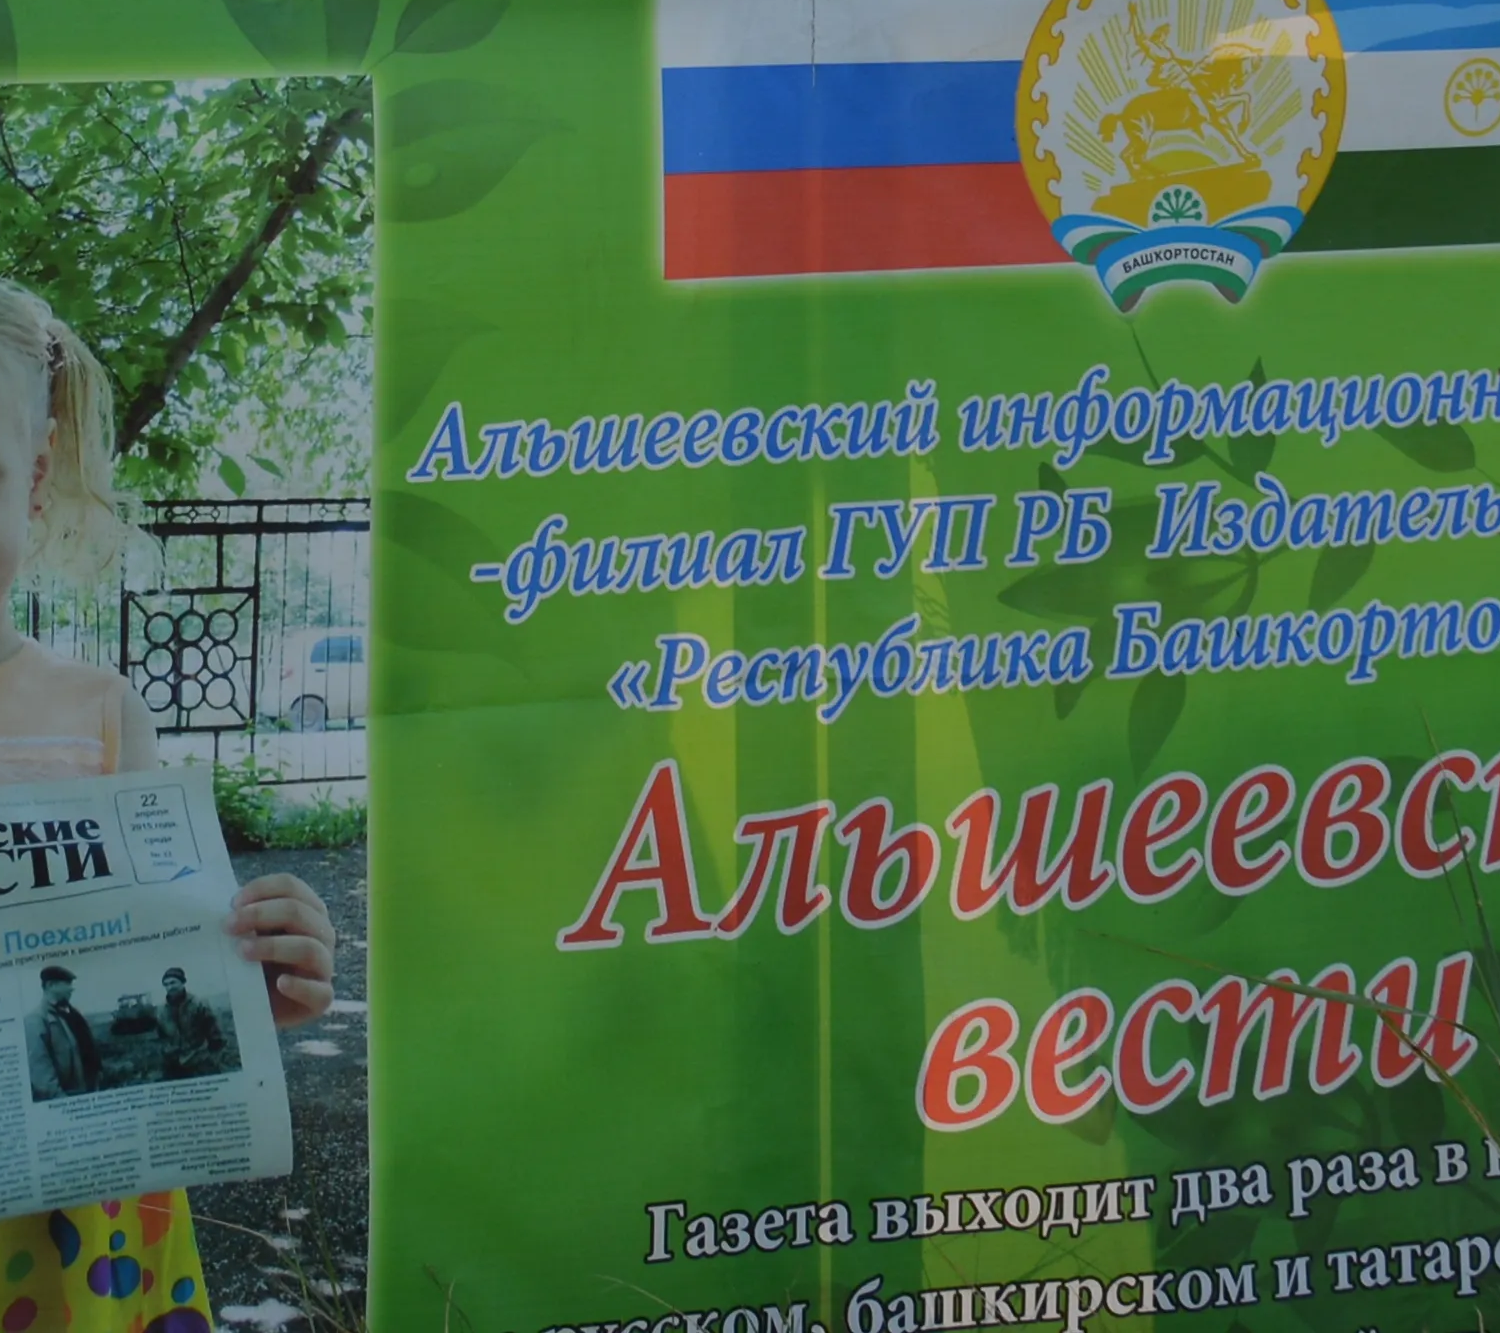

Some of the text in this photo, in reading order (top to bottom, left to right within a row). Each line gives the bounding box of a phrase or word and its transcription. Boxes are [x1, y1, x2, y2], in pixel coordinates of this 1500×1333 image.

[407, 379, 937, 481] Альшеевский
[470, 515, 805, 623] -филиал
[823, 495, 995, 579] ГУП
[1006, 488, 1111, 566] РБ
[608, 614, 1092, 724] «Республика
[140, 793, 159, 807] 22
[3, 912, 132, 954] Поехали!
[916, 949, 1479, 1134] вести
[646, 1198, 853, 1263] Газета
[870, 1174, 1156, 1242] выходит
[1170, 1161, 1273, 1225] два
[1287, 1146, 1421, 1217] раза
[1434, 1139, 1469, 1184] в
[845, 1263, 1258, 1333] башкирском
[1274, 1255, 1312, 1299] и
